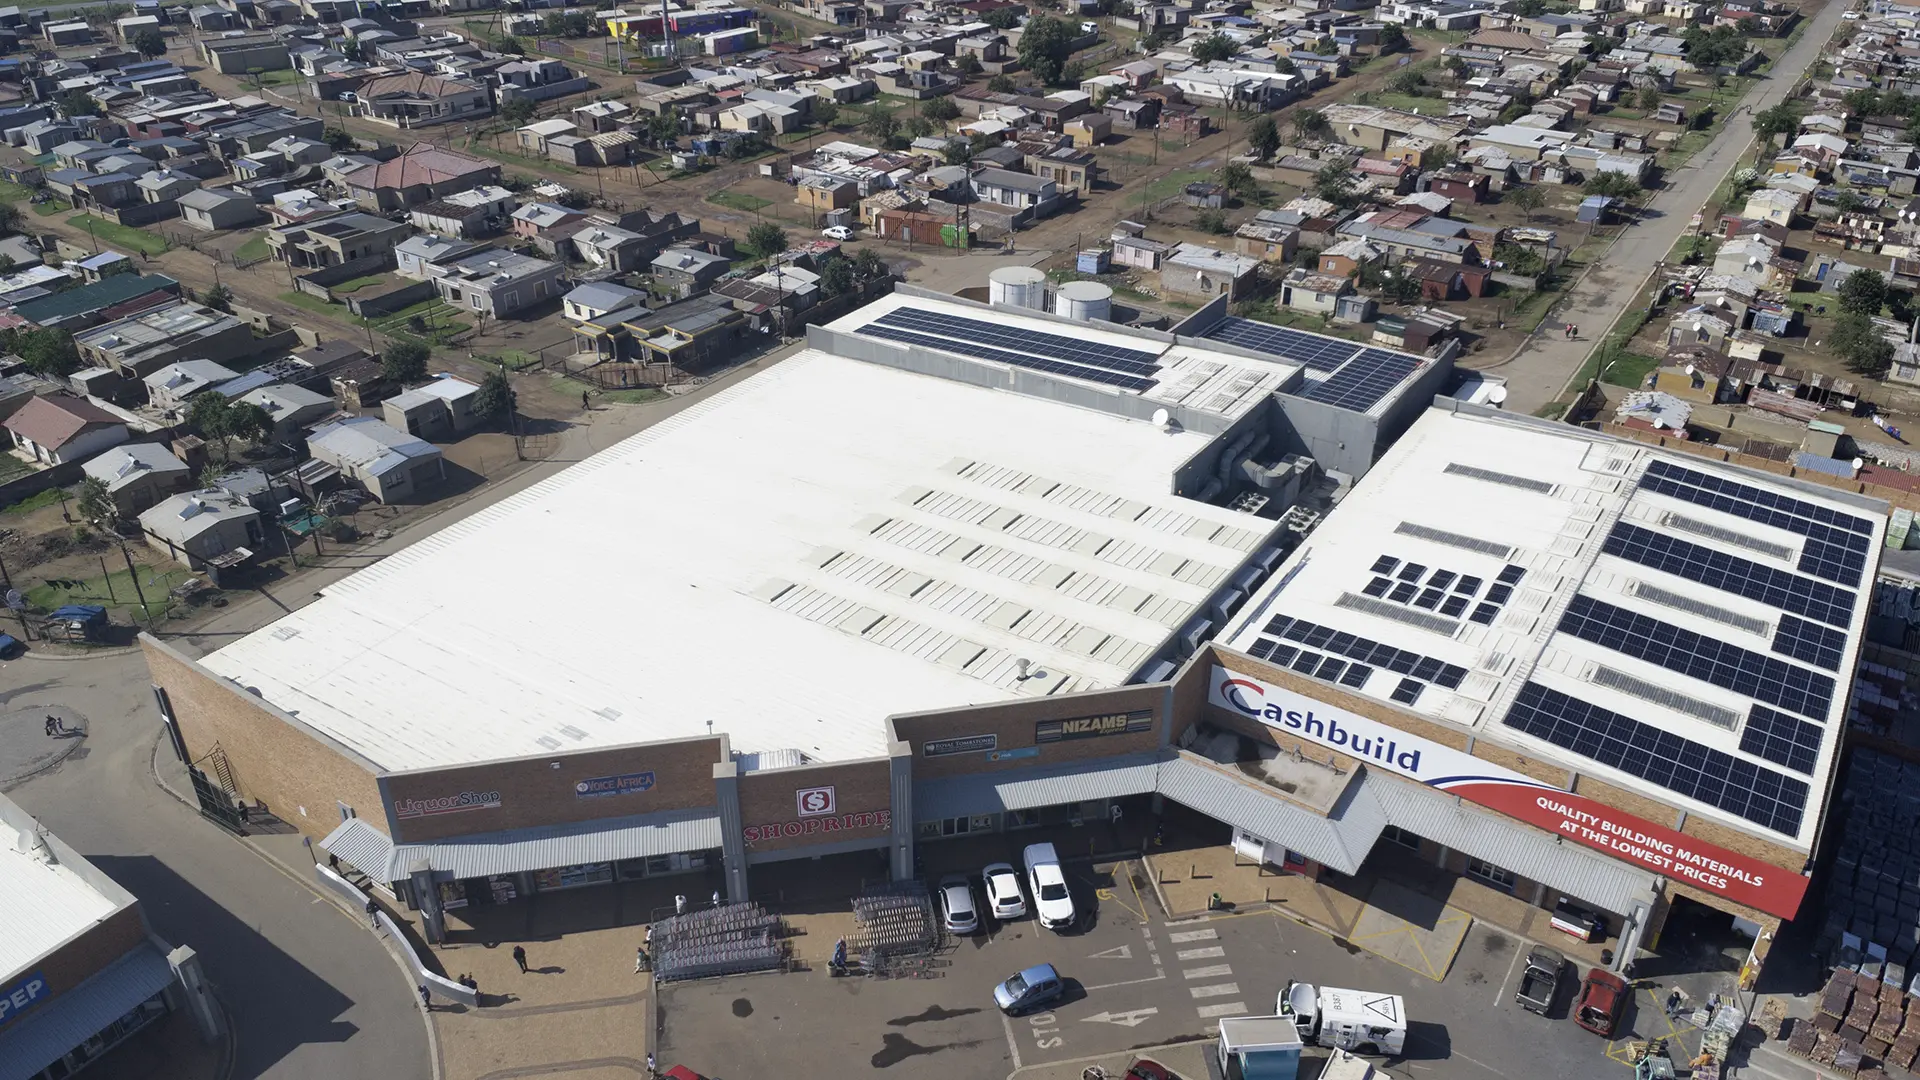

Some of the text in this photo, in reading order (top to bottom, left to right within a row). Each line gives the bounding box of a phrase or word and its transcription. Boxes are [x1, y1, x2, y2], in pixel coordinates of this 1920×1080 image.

[1062, 714, 1127, 734] NIZAMS
[1220, 678, 1421, 774] Cashbuild
[588, 780, 615, 791] VOICE
[617, 775, 652, 788] AFRICA
[744, 810, 892, 841] SHOPRITE
[1536, 797, 1764, 887] QUALITY BUILDING MATERIALS
[1560, 820, 1728, 889] AT THE LOWEST PRICES
[0, 980, 42, 1019] PEP
[1029, 1013, 1063, 1049] STO
